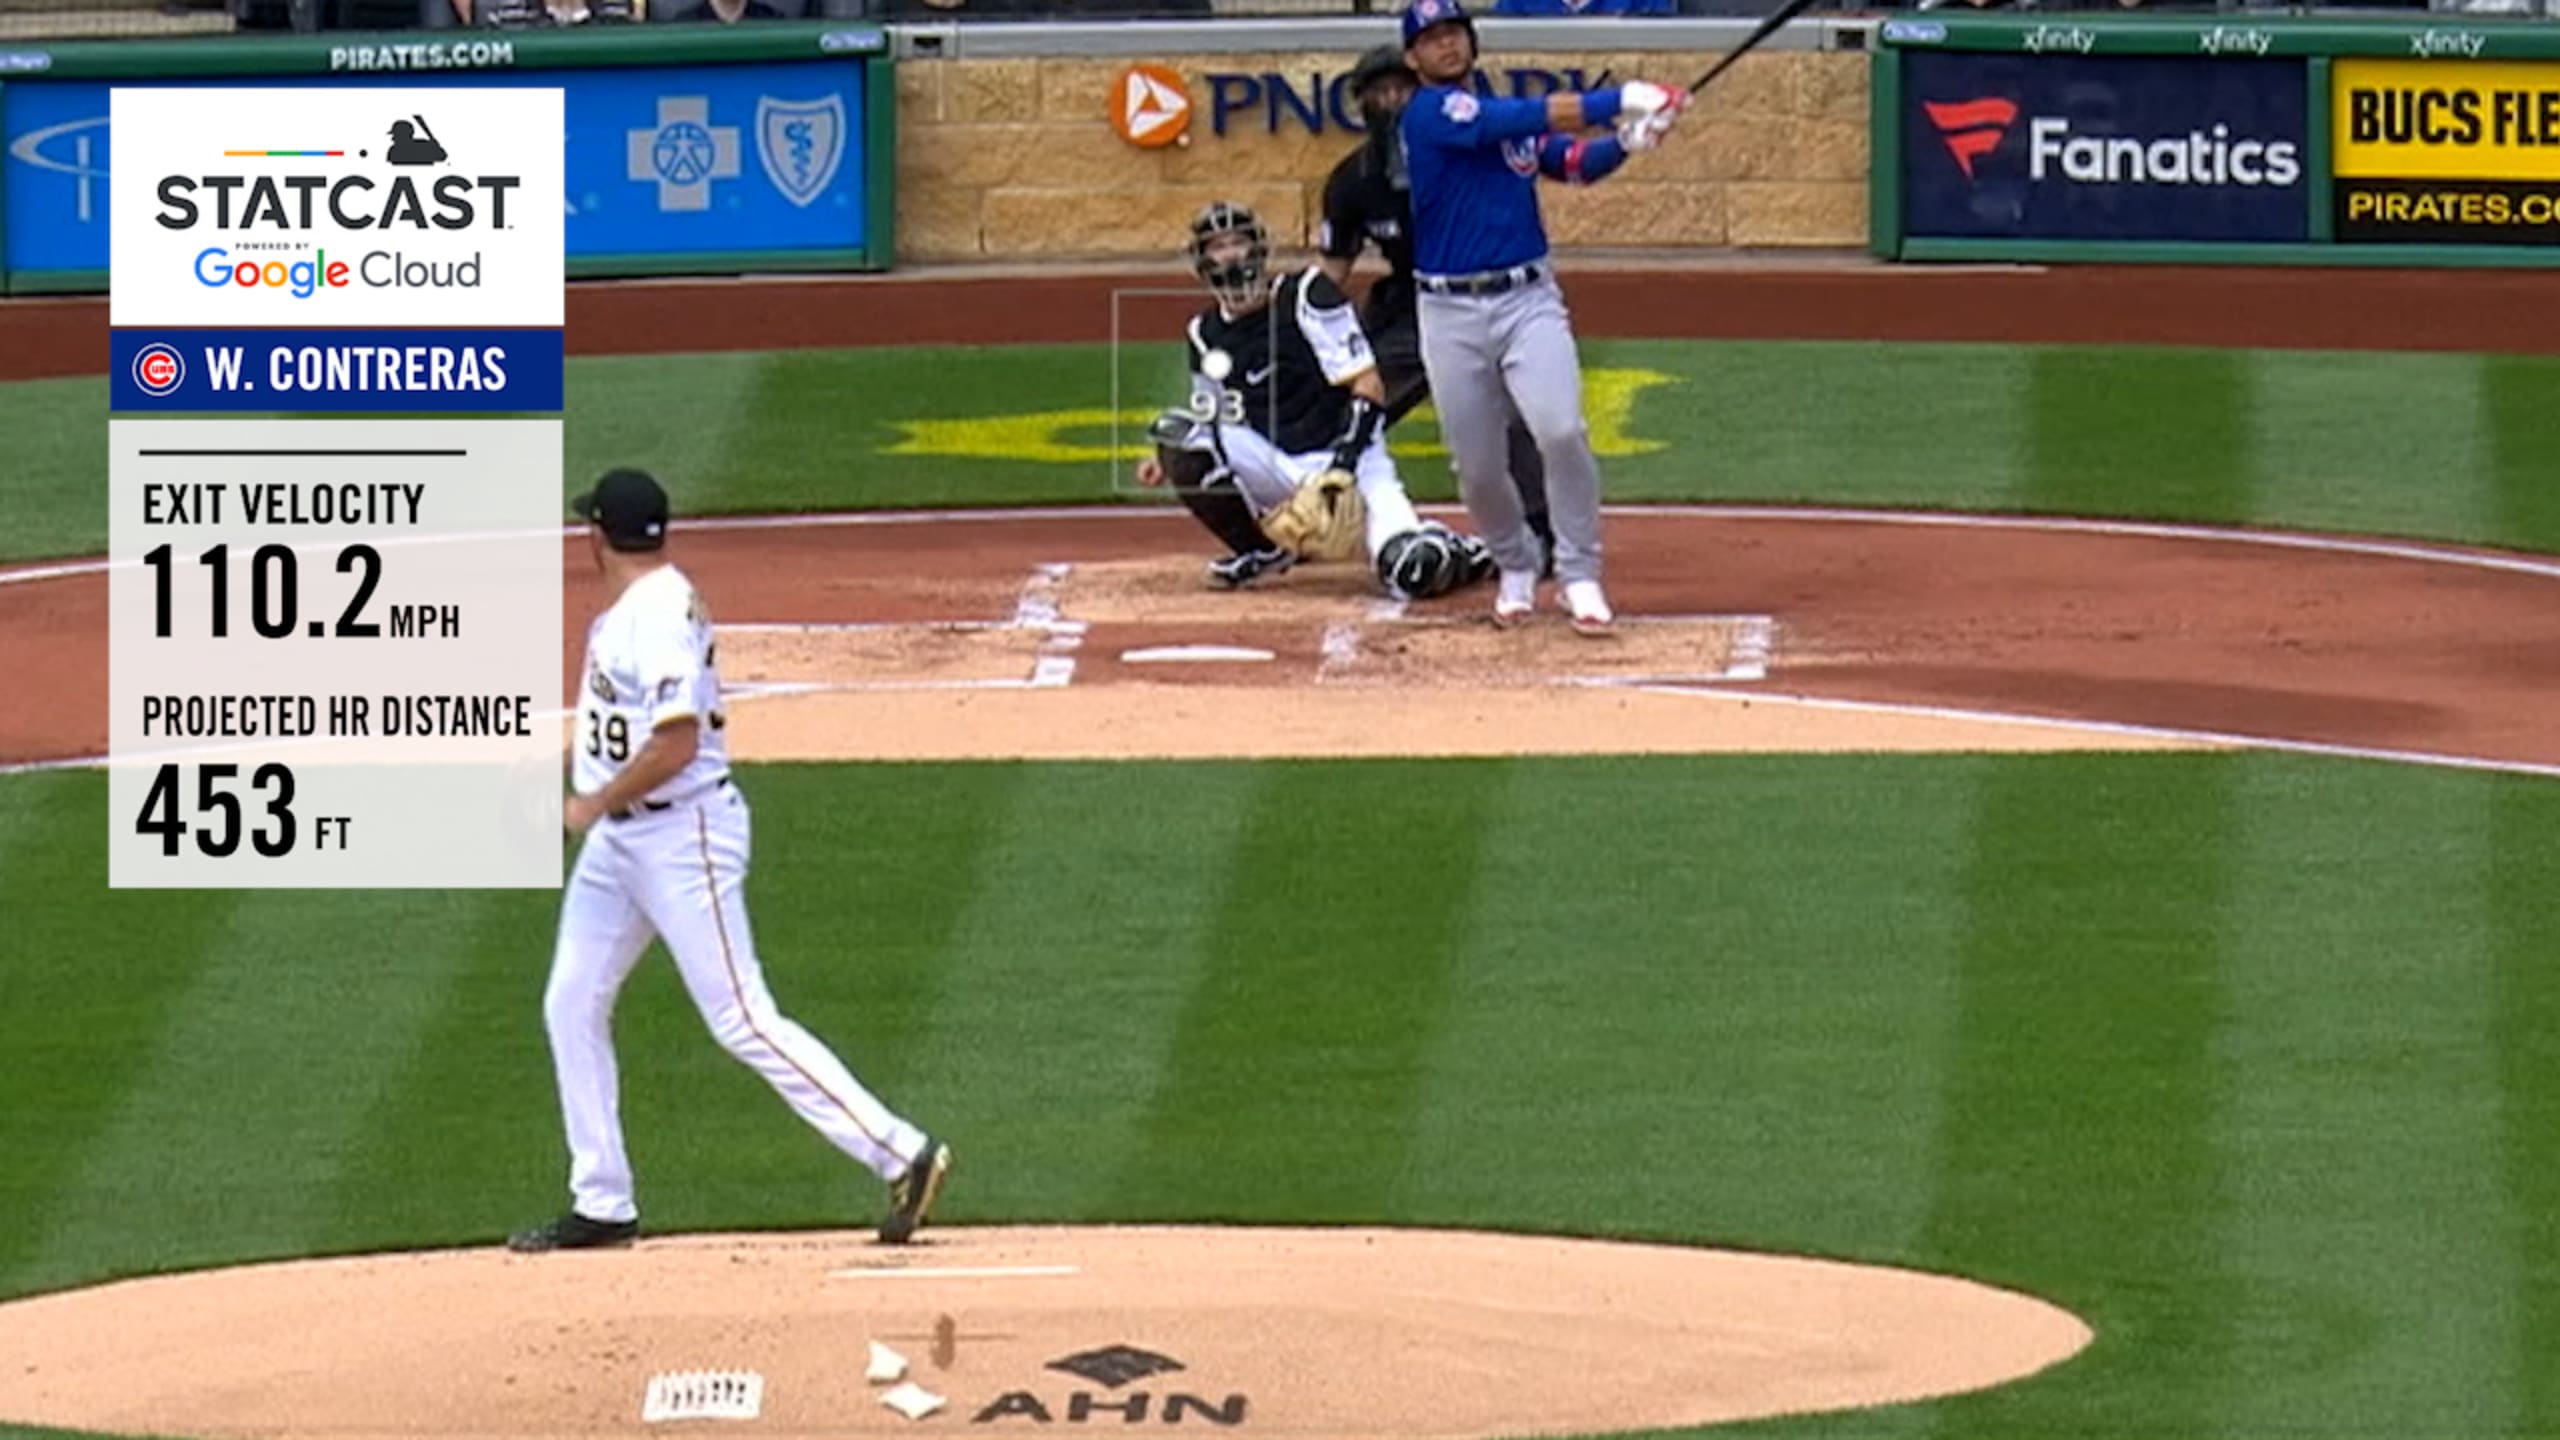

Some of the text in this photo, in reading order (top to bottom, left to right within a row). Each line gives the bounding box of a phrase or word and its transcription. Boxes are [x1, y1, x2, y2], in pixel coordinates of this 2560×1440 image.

[330, 42, 514, 70] PIRATES.COM
[2024, 25, 2096, 54] xfinity
[2201, 25, 2272, 56] xfinity
[2410, 28, 2486, 58] xfinity
[1206, 73, 1368, 137] PNC
[2351, 89, 2481, 144] BUCS
[2030, 117, 2300, 185] Fanatics
[2349, 192, 2560, 225] PIRATES.C
[587, 709, 629, 762] 39
[971, 1391, 1247, 1425] AHN
